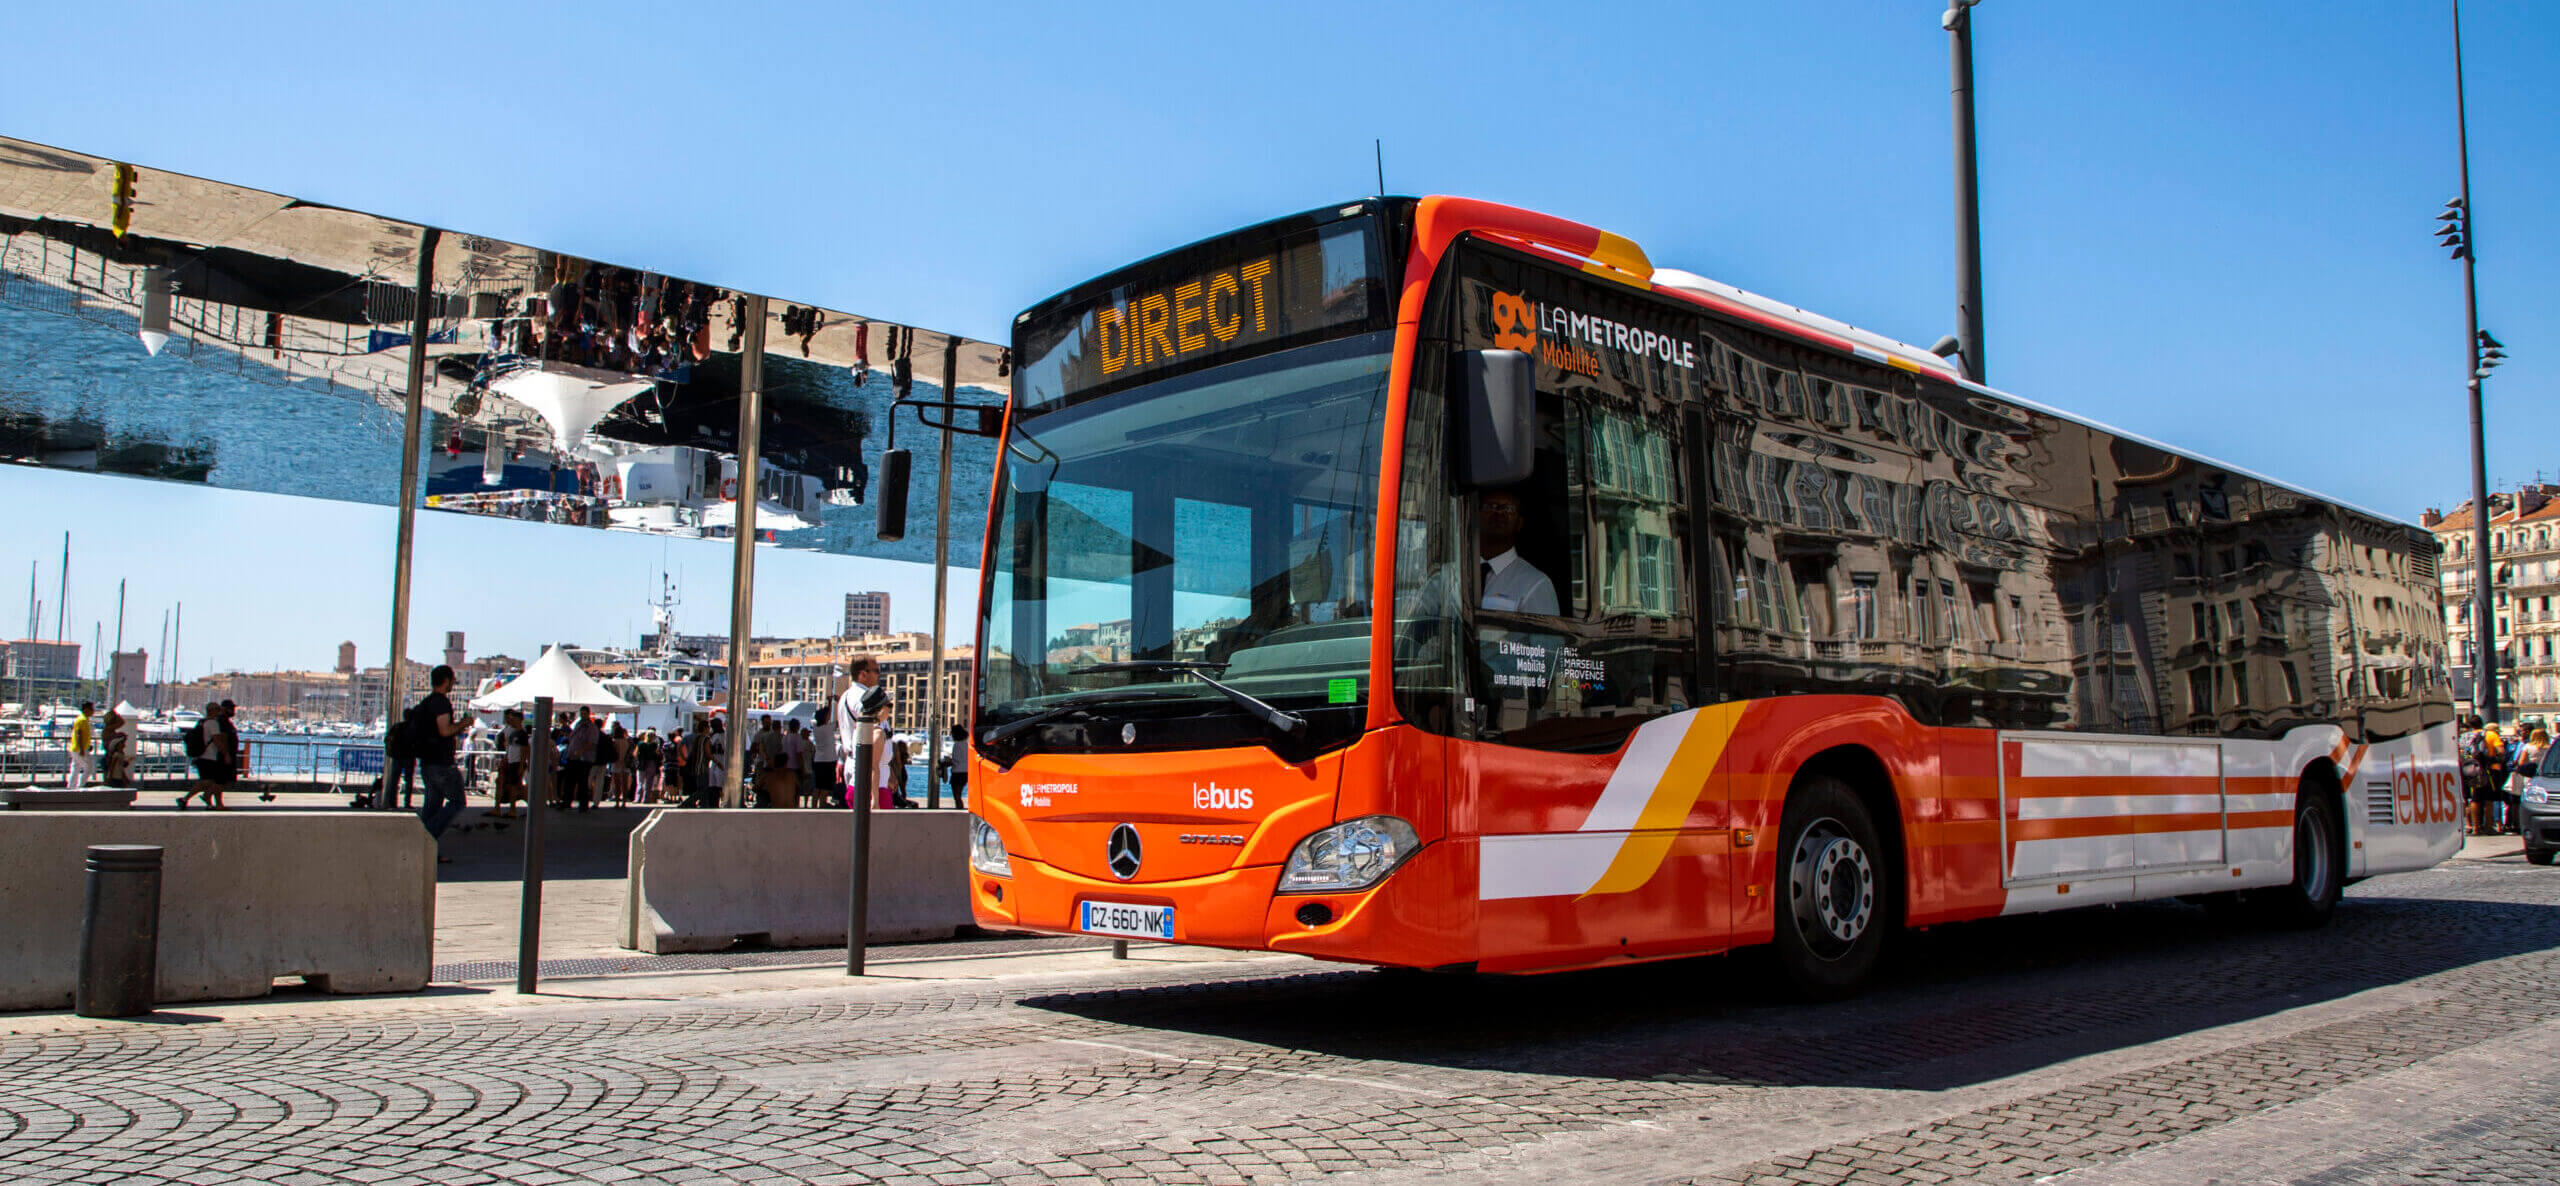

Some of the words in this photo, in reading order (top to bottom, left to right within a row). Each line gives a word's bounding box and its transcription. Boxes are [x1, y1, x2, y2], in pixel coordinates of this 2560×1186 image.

[1099, 259, 1272, 375] DIRECT
[1542, 338, 1600, 377] Mobilité
[1500, 640, 1509, 655] La
[1510, 642, 1545, 658] Métropole
[1517, 658, 1546, 673] Mobilité
[1564, 658, 1605, 671] MARSEILLE
[1494, 674, 1508, 685] une
[1509, 675, 1536, 688] marque
[1537, 675, 1546, 688] de
[1564, 669, 1605, 681] PROVENCE
[1193, 781, 1254, 809] lebus
[2390, 753, 2457, 825] lebus
